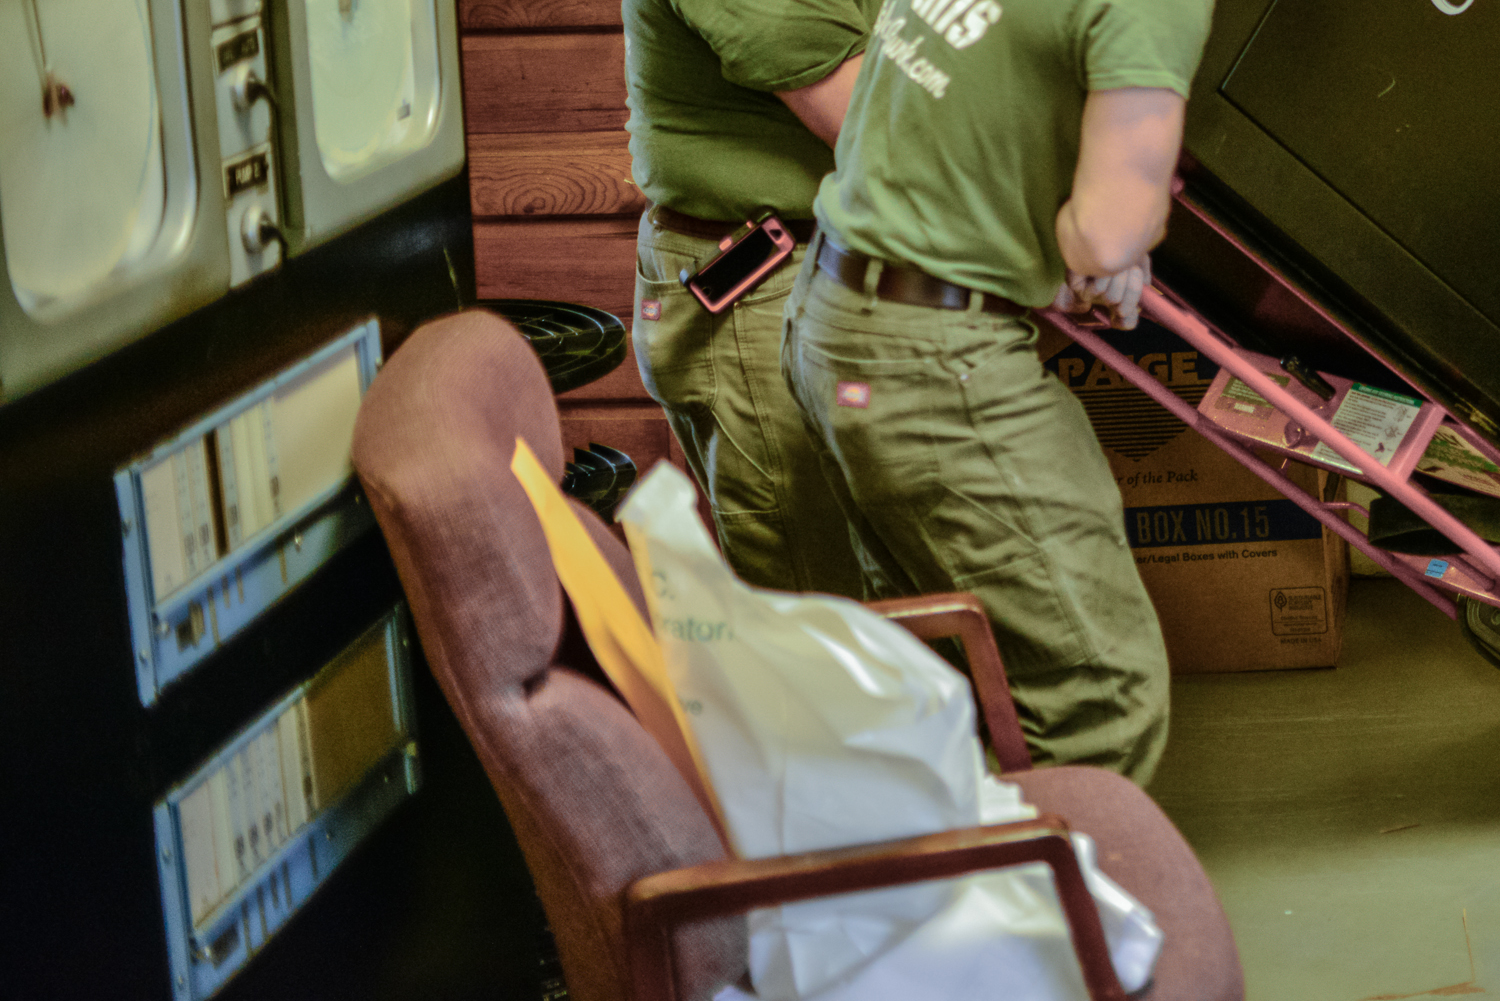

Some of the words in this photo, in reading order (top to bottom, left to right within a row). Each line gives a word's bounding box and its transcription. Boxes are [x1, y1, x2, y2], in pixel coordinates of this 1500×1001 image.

[1127, 472, 1142, 488] of
[1143, 472, 1162, 483] the
[1167, 469, 1199, 483] Pack
[1136, 510, 1187, 544] BOX
[1182, 552, 1215, 562] Boxes
[1217, 550, 1239, 559] with
[1242, 549, 1278, 558] Covers
